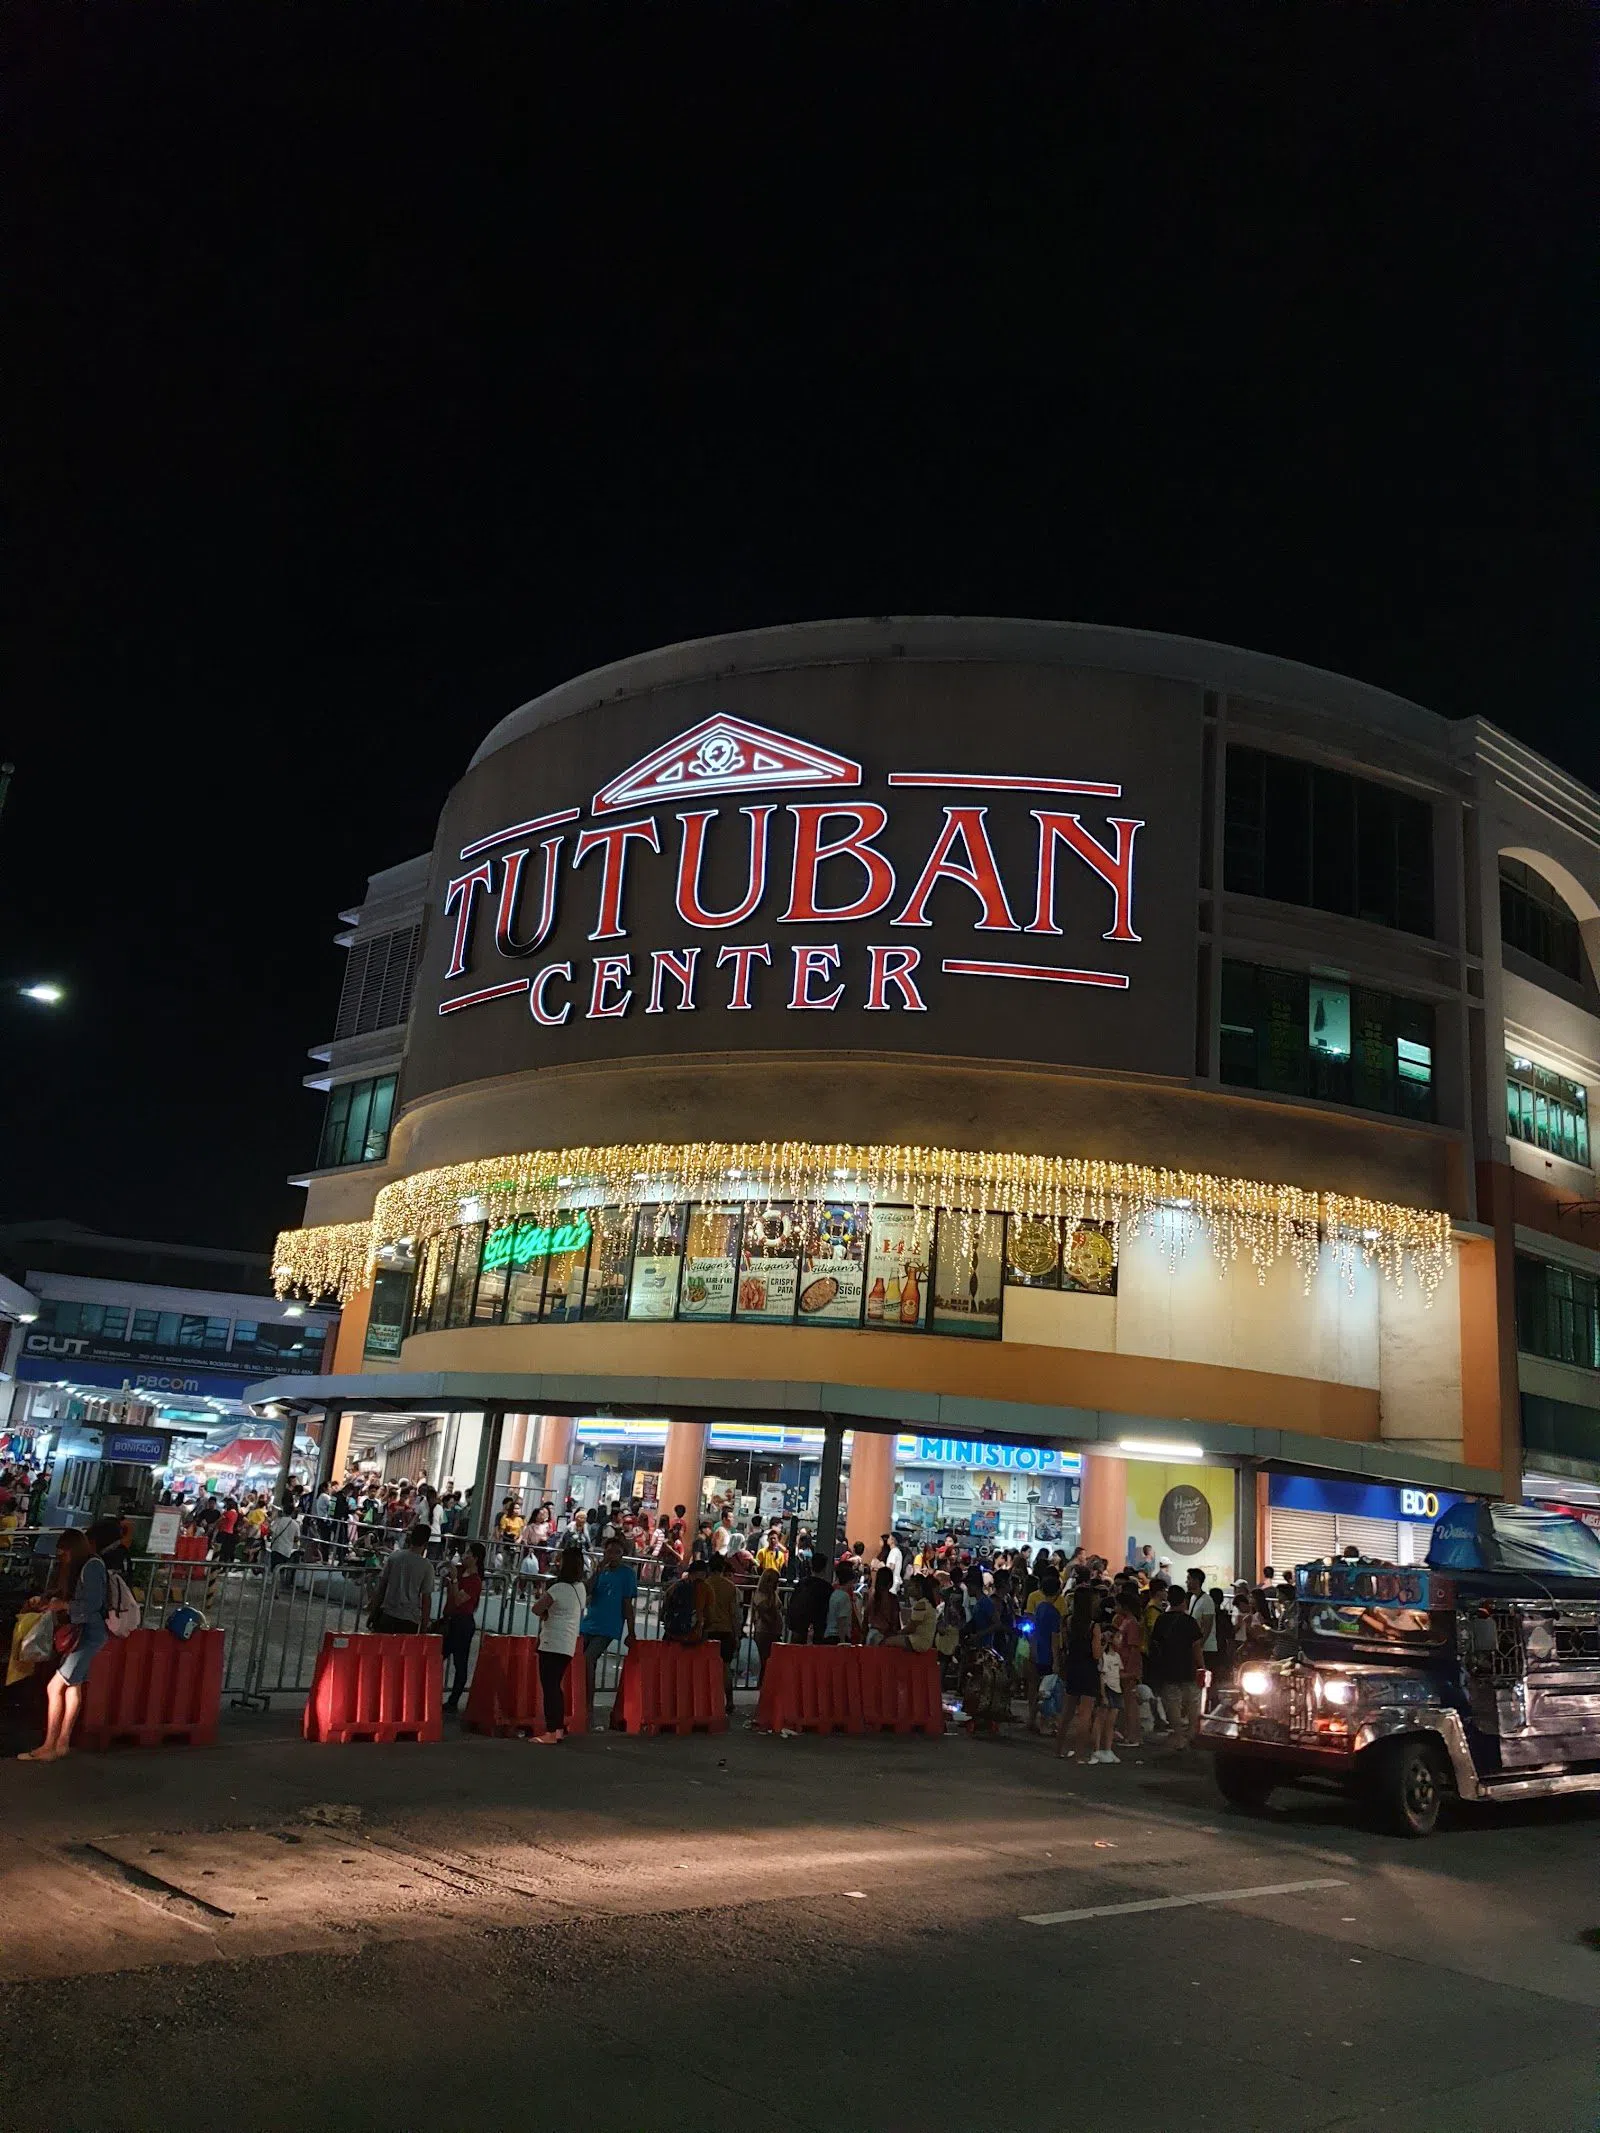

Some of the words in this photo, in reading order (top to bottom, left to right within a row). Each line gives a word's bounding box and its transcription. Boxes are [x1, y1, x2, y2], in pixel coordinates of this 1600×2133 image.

[445, 802, 1146, 979] TUTUBAN
[530, 943, 927, 1026] CENTER
[749, 1261, 792, 1272] Giligan's
[812, 1263, 856, 1274] Giligan's
[770, 1278, 794, 1286] CRISPY
[777, 1286, 794, 1294] PATA
[839, 1285, 861, 1296] SISIG
[27, 1335, 90, 1355] CUT
[114, 1442, 161, 1454] BONIFACIO
[920, 1438, 1056, 1470] MINISTOP
[1401, 1489, 1439, 1518] BDO
[1169, 1535, 1205, 1545] MINISTOP
